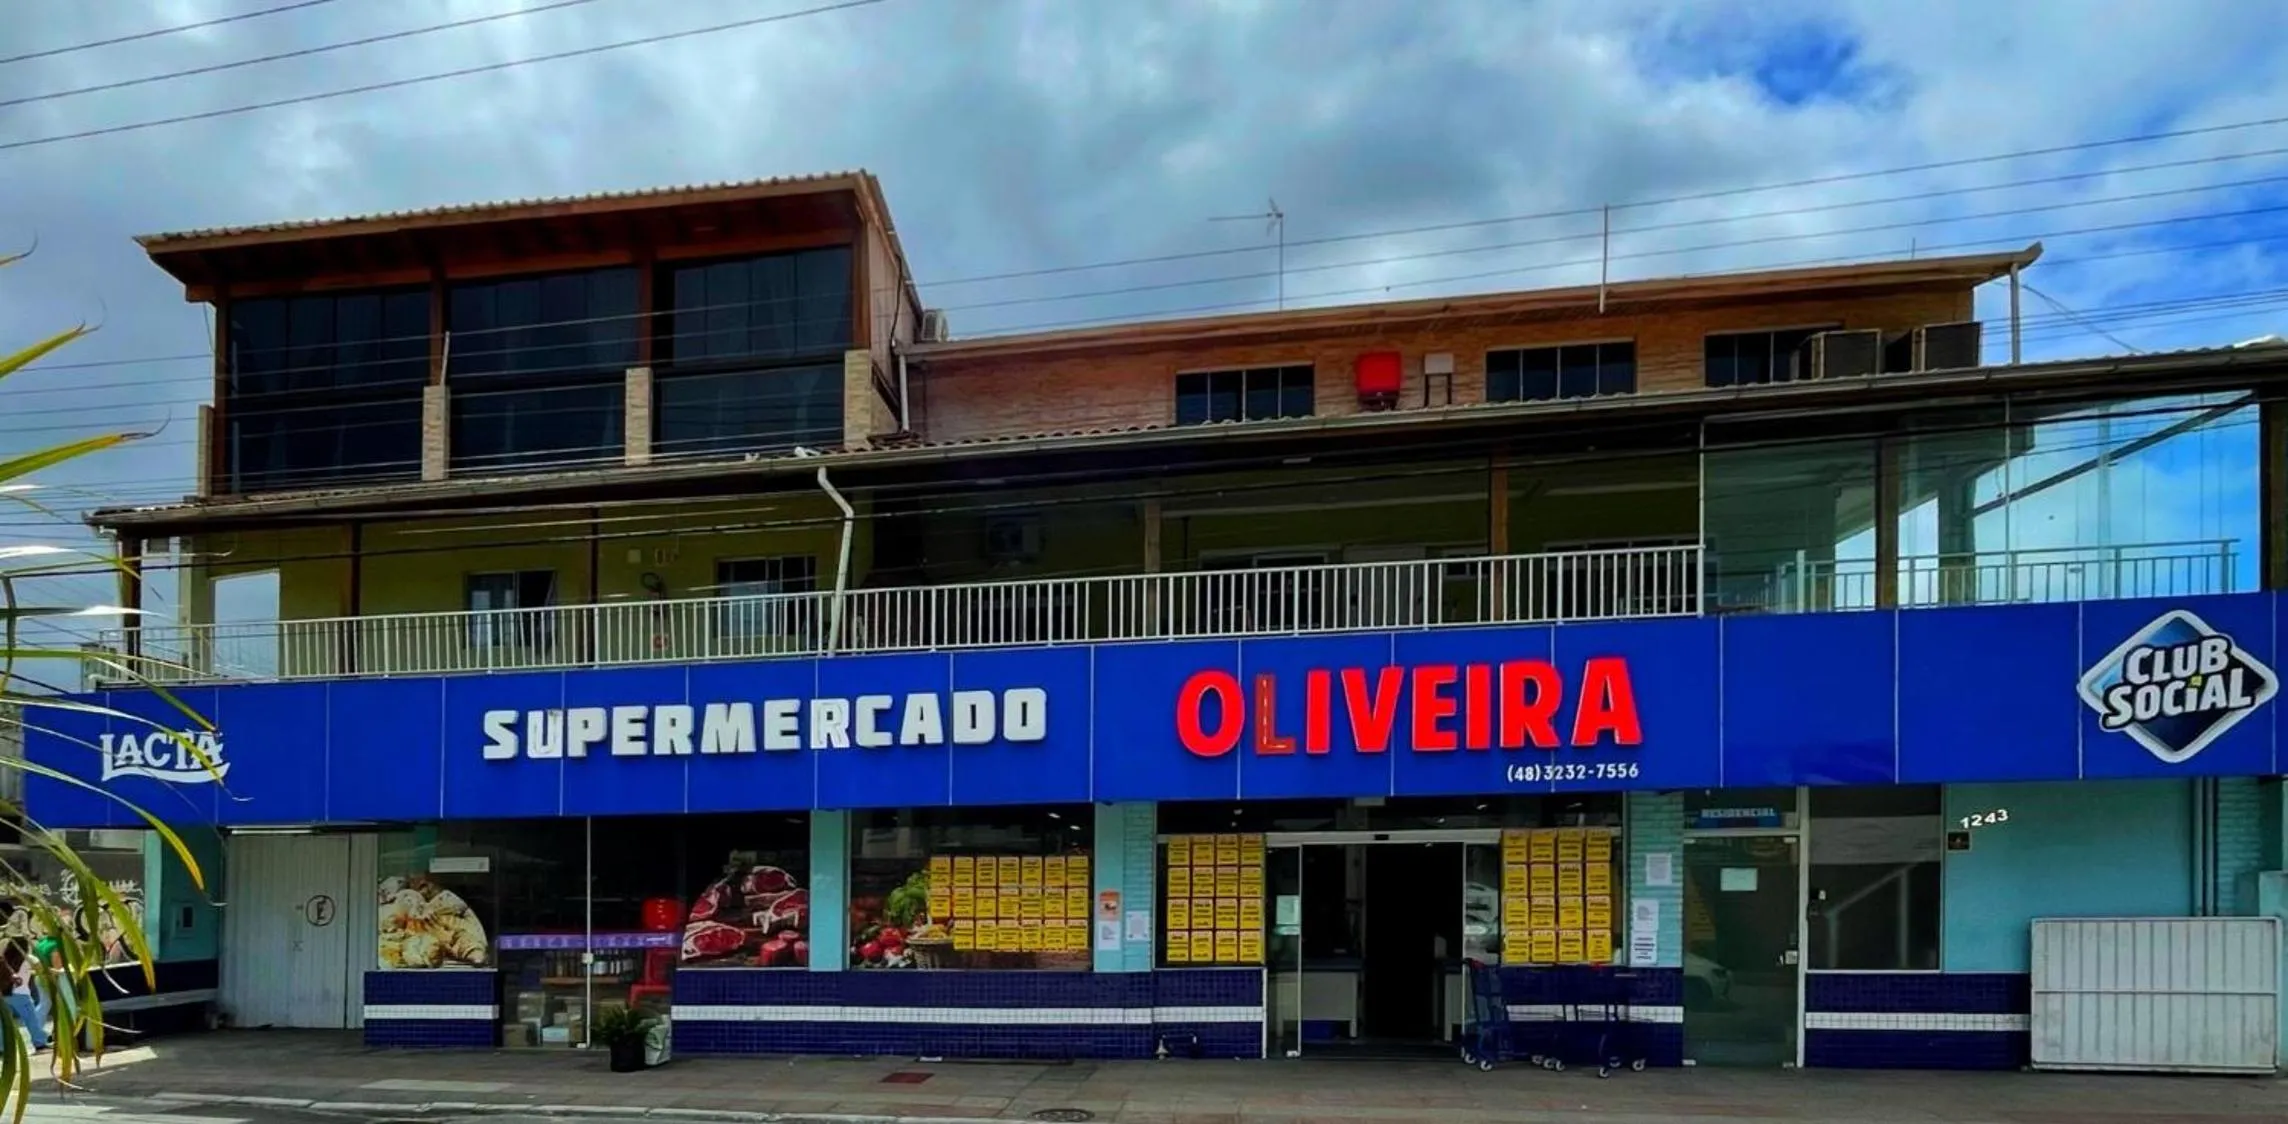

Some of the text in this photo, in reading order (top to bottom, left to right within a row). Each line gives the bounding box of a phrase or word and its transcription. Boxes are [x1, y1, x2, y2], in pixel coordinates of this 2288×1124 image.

[2126, 638, 2229, 684] CLUB
[483, 687, 1046, 760] SUPERMERCADO
[1177, 657, 1642, 757] OLIVEIRA
[99, 732, 228, 783] LACTA
[1960, 809, 2009, 829] 1243
